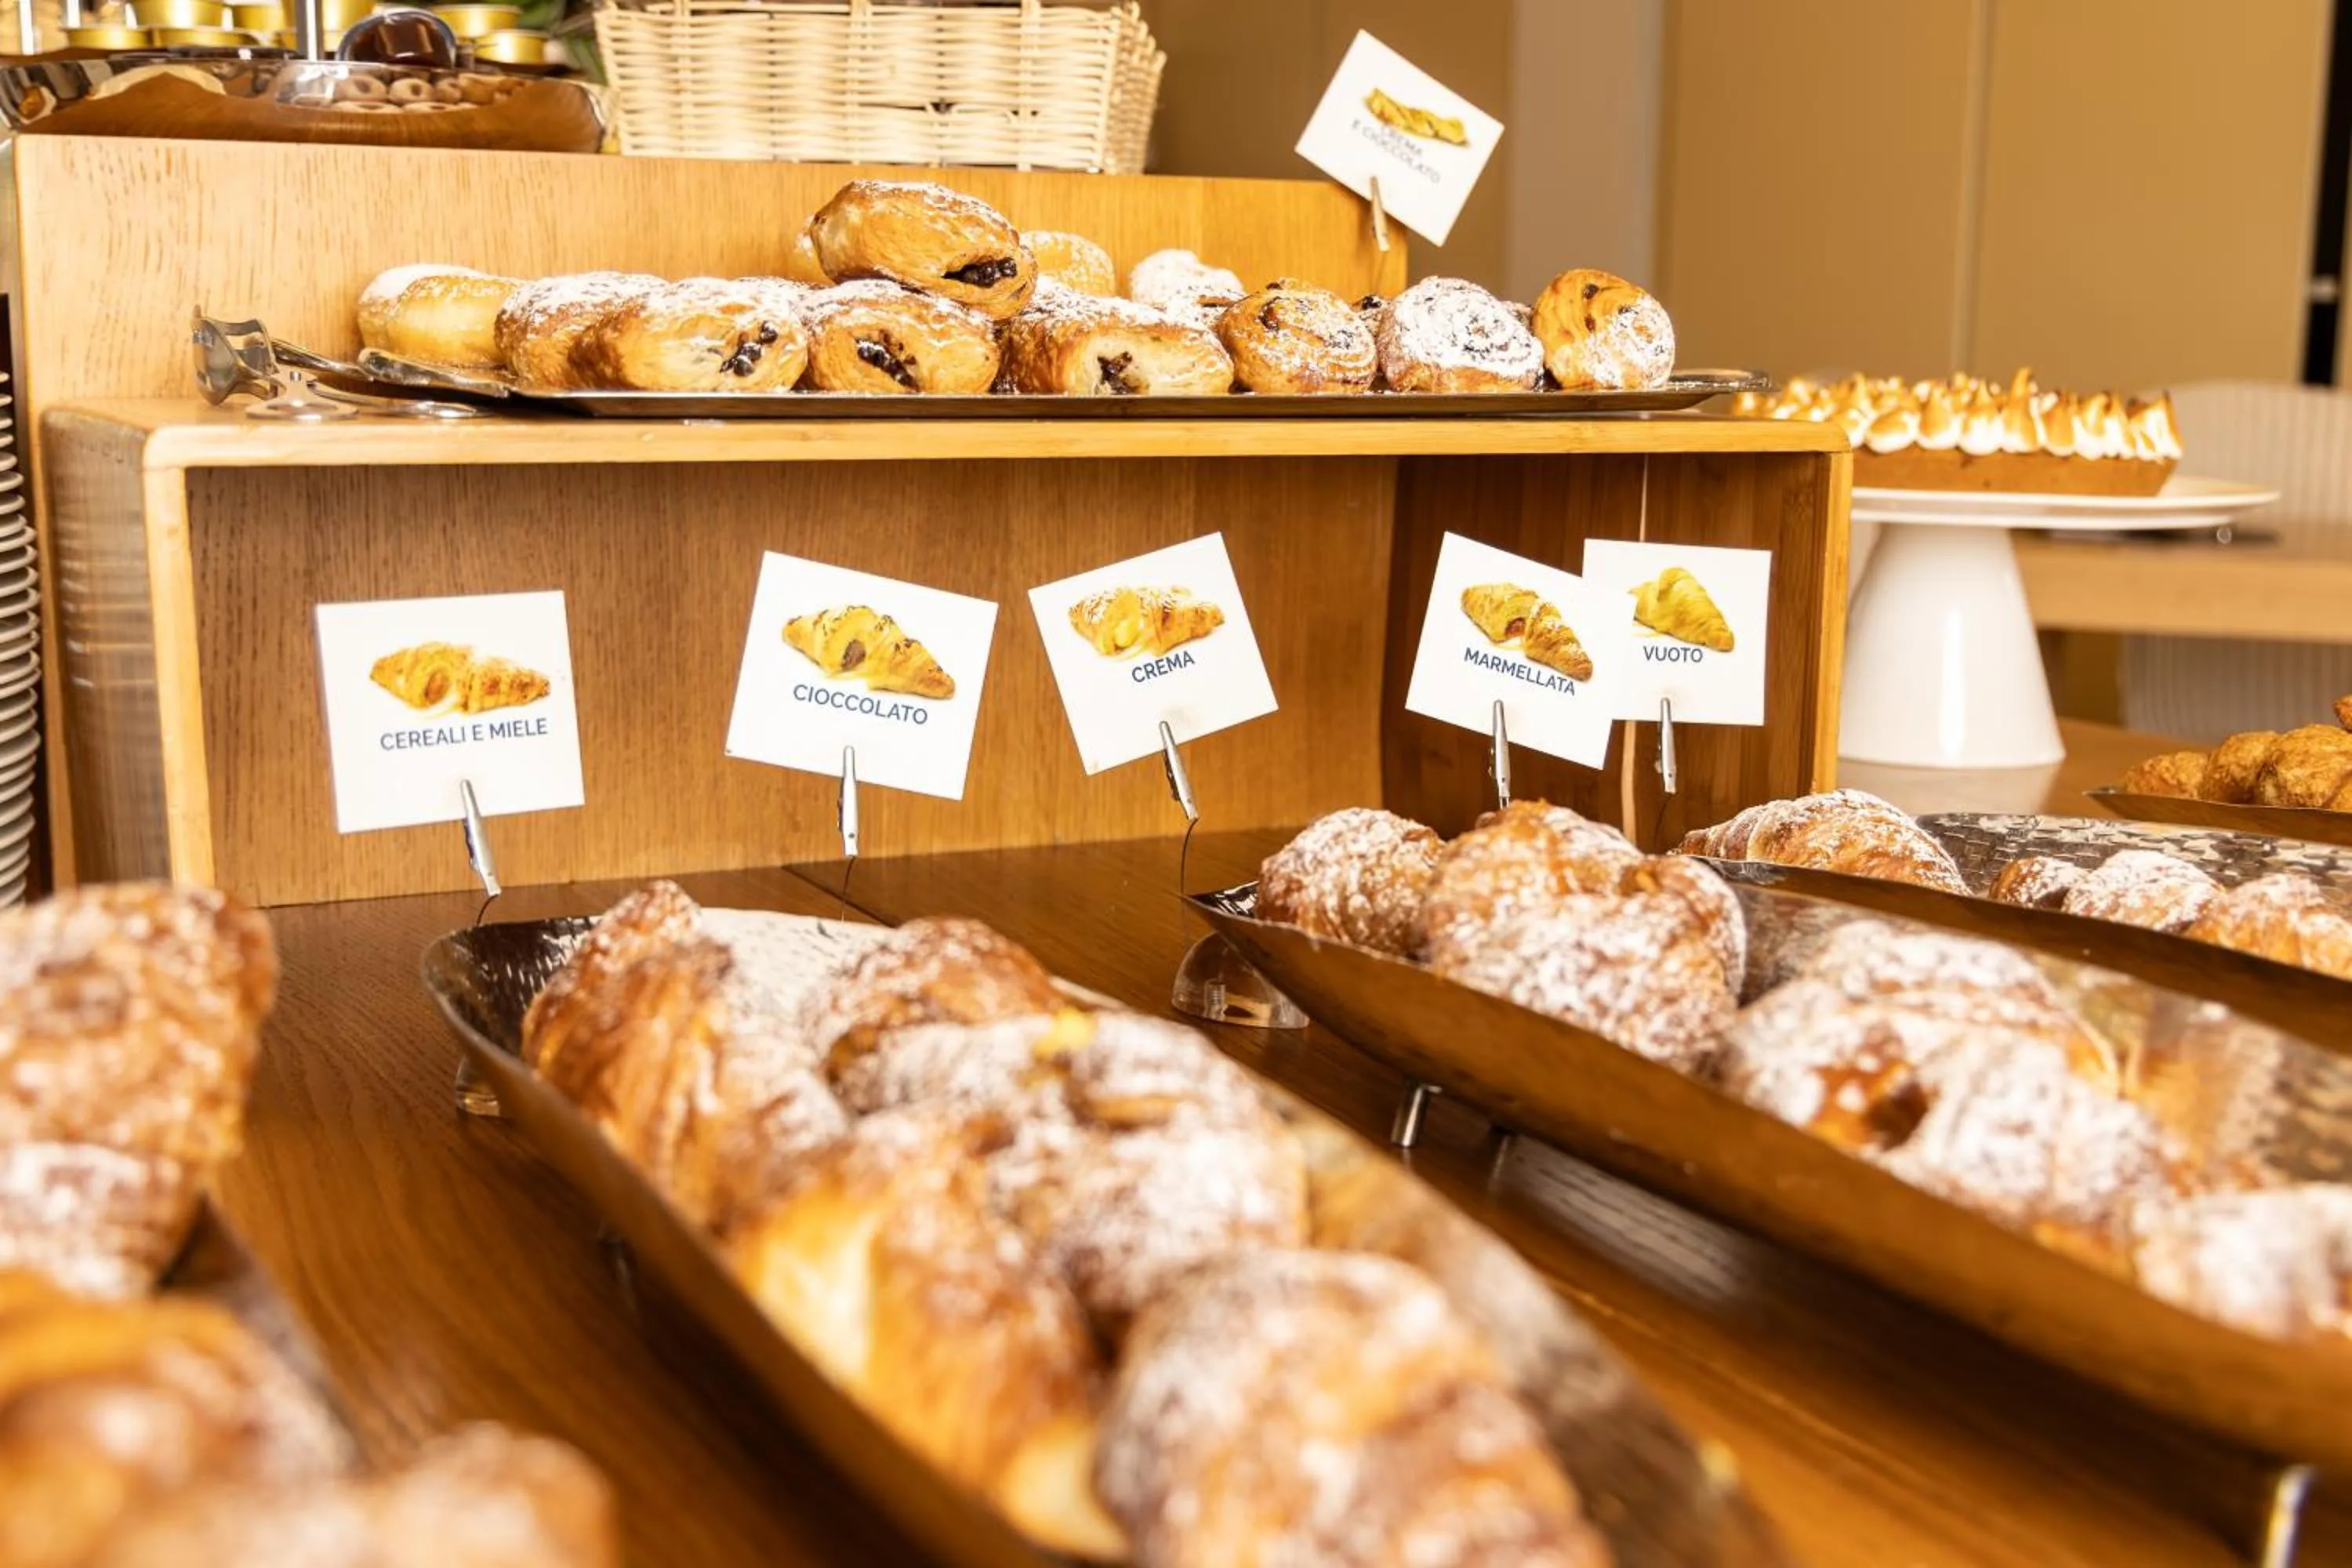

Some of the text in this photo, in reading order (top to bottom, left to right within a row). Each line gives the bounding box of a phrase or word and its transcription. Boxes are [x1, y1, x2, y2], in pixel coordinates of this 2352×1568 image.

[1131, 650, 1196, 683] CREMA
[1642, 644, 1703, 663] VUOTO
[1463, 647, 1576, 696] MARMELLATA
[793, 684, 928, 724] CIOCCOLATO
[380, 717, 548, 751] CEREALI E MIELE
